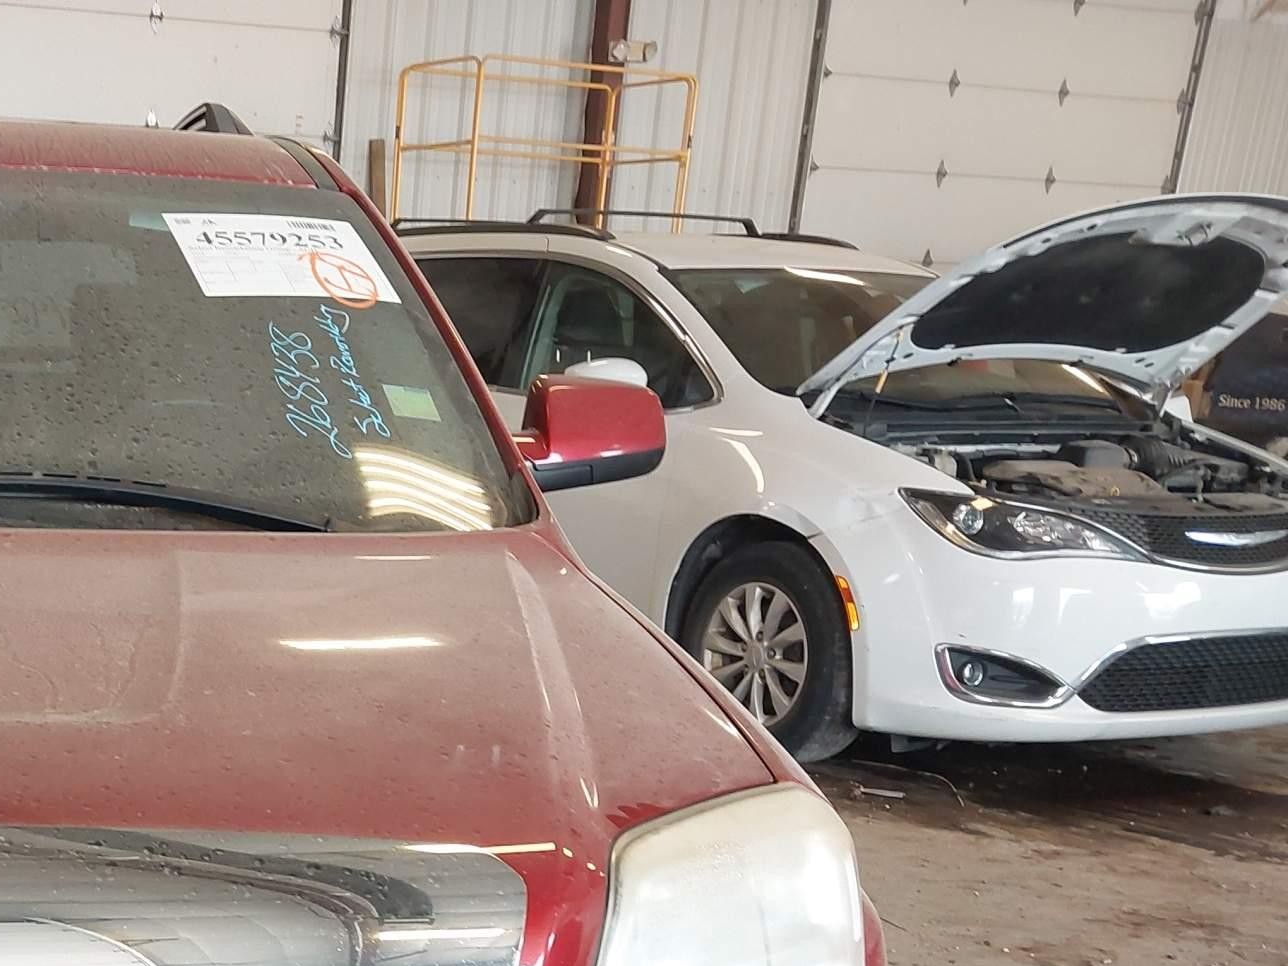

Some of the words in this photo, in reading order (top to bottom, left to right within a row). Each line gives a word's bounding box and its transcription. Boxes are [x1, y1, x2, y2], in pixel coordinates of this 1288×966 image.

[195, 230, 344, 250] 45579253
[1217, 393, 1252, 409] Since
[1254, 395, 1287, 412] 1986
